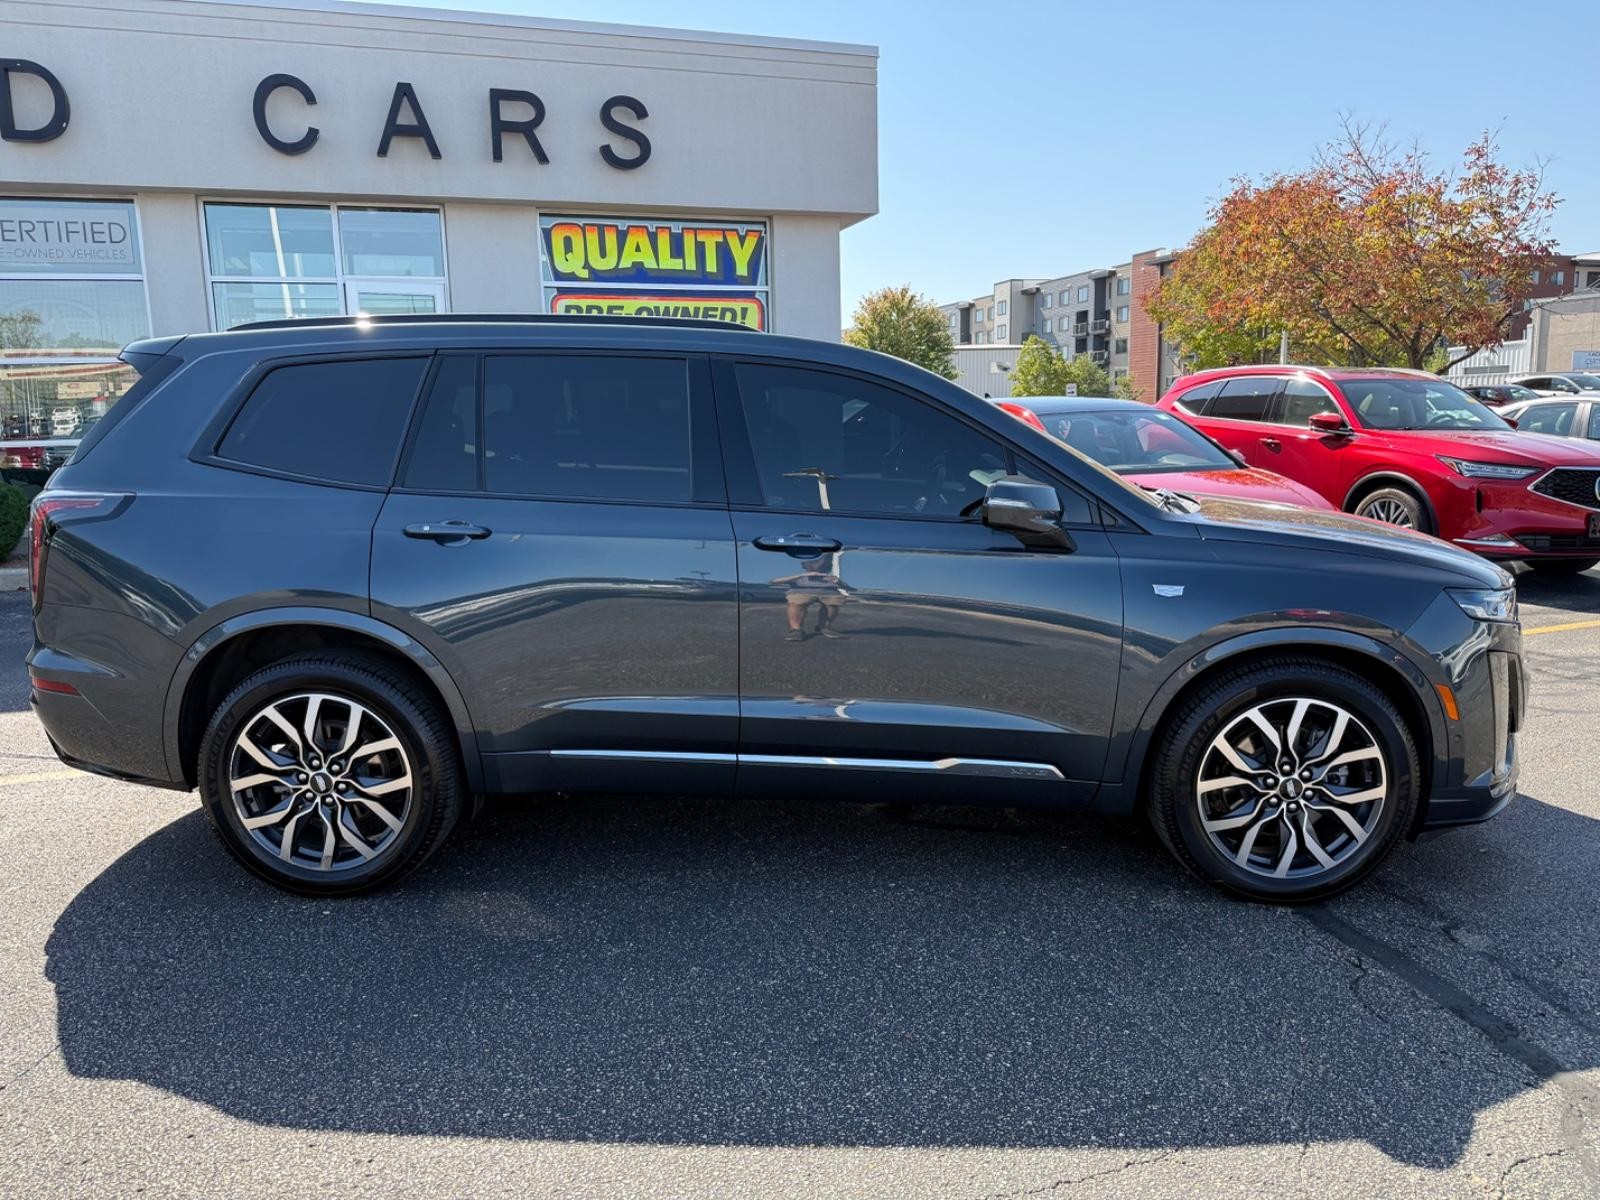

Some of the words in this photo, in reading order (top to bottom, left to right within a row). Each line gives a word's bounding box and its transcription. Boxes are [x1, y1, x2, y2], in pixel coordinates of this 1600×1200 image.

[0, 58, 71, 143] D
[253, 73, 652, 171] CARS
[0, 220, 127, 244] ERTIFIED
[551, 222, 762, 279] QUALITY
[69, 249, 127, 260] VEHICLES
